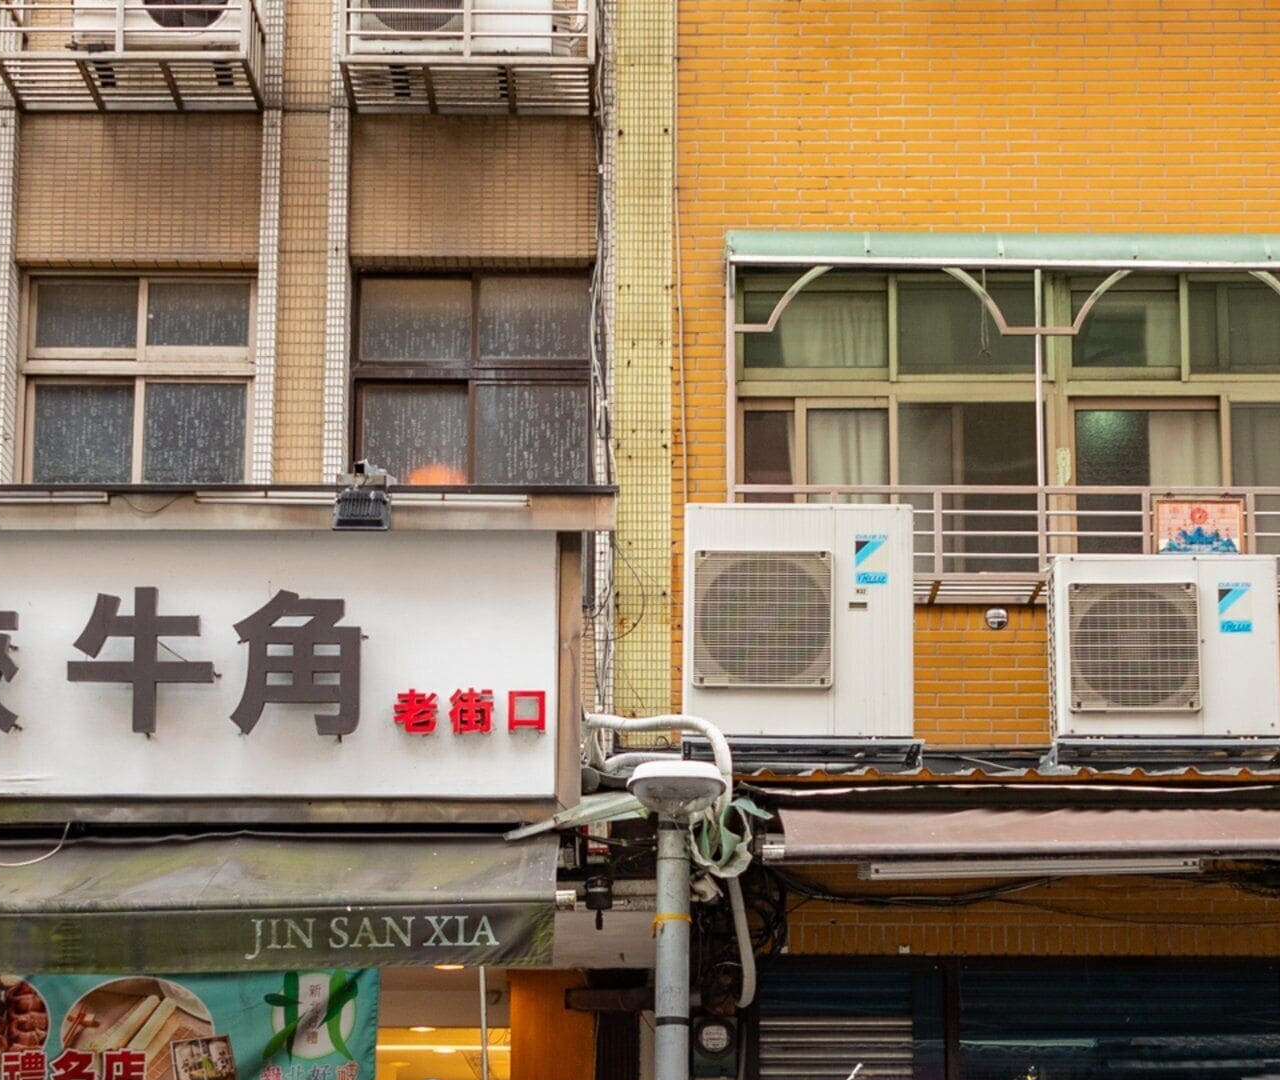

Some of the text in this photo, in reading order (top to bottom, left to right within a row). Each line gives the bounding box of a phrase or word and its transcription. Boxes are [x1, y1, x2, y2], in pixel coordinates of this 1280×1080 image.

[393, 688, 547, 734] 老街口
[244, 915, 500, 960] JIN SAN XIA
